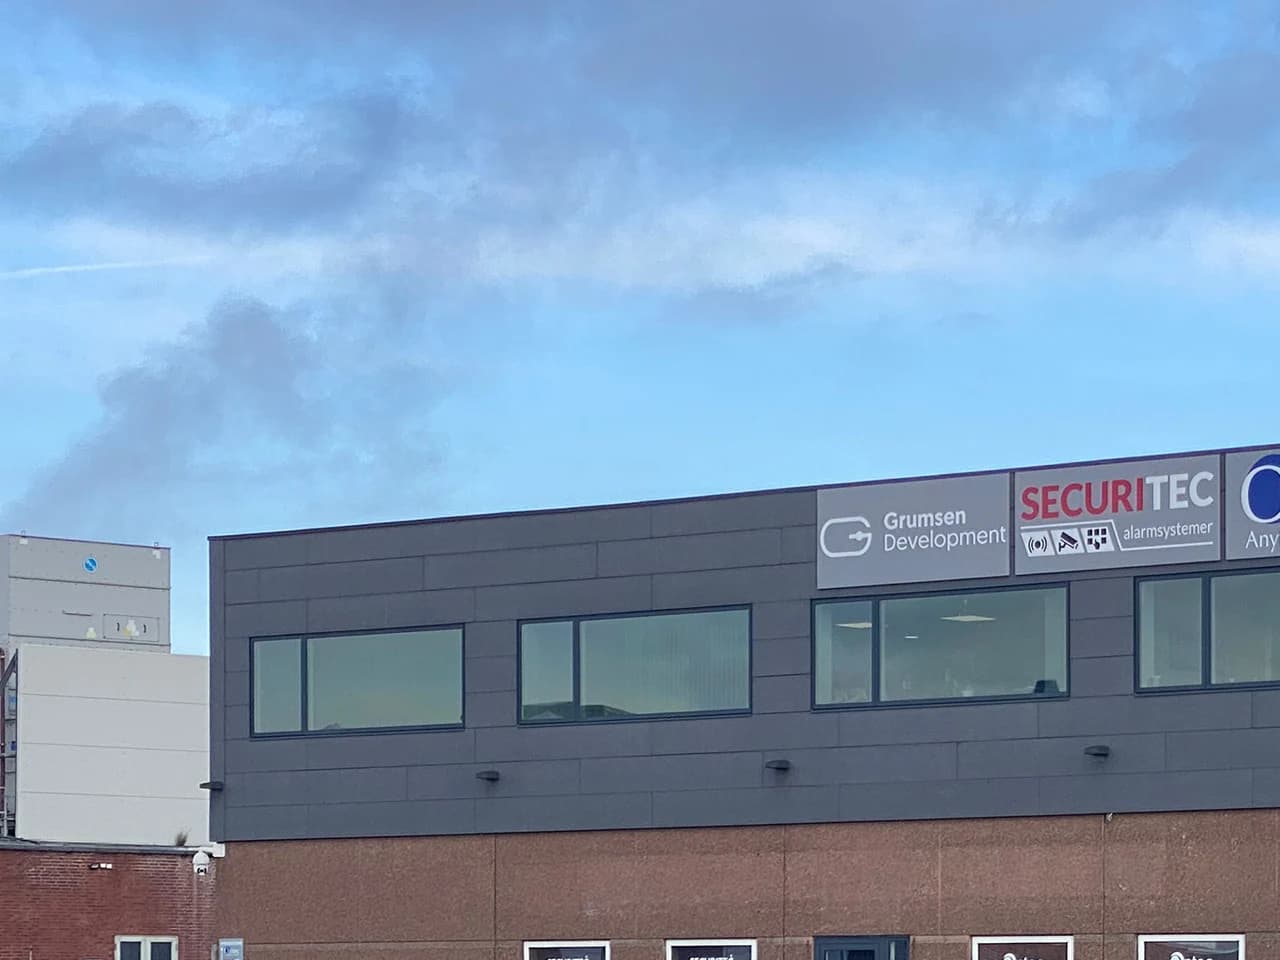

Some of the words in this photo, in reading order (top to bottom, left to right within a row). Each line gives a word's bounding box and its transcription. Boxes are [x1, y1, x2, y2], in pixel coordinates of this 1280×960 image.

[1021, 471, 1214, 521] SECURITEC
[883, 510, 967, 530] Grumsen
[884, 526, 1007, 551] Development
[1123, 521, 1214, 544] alarmsystemer
